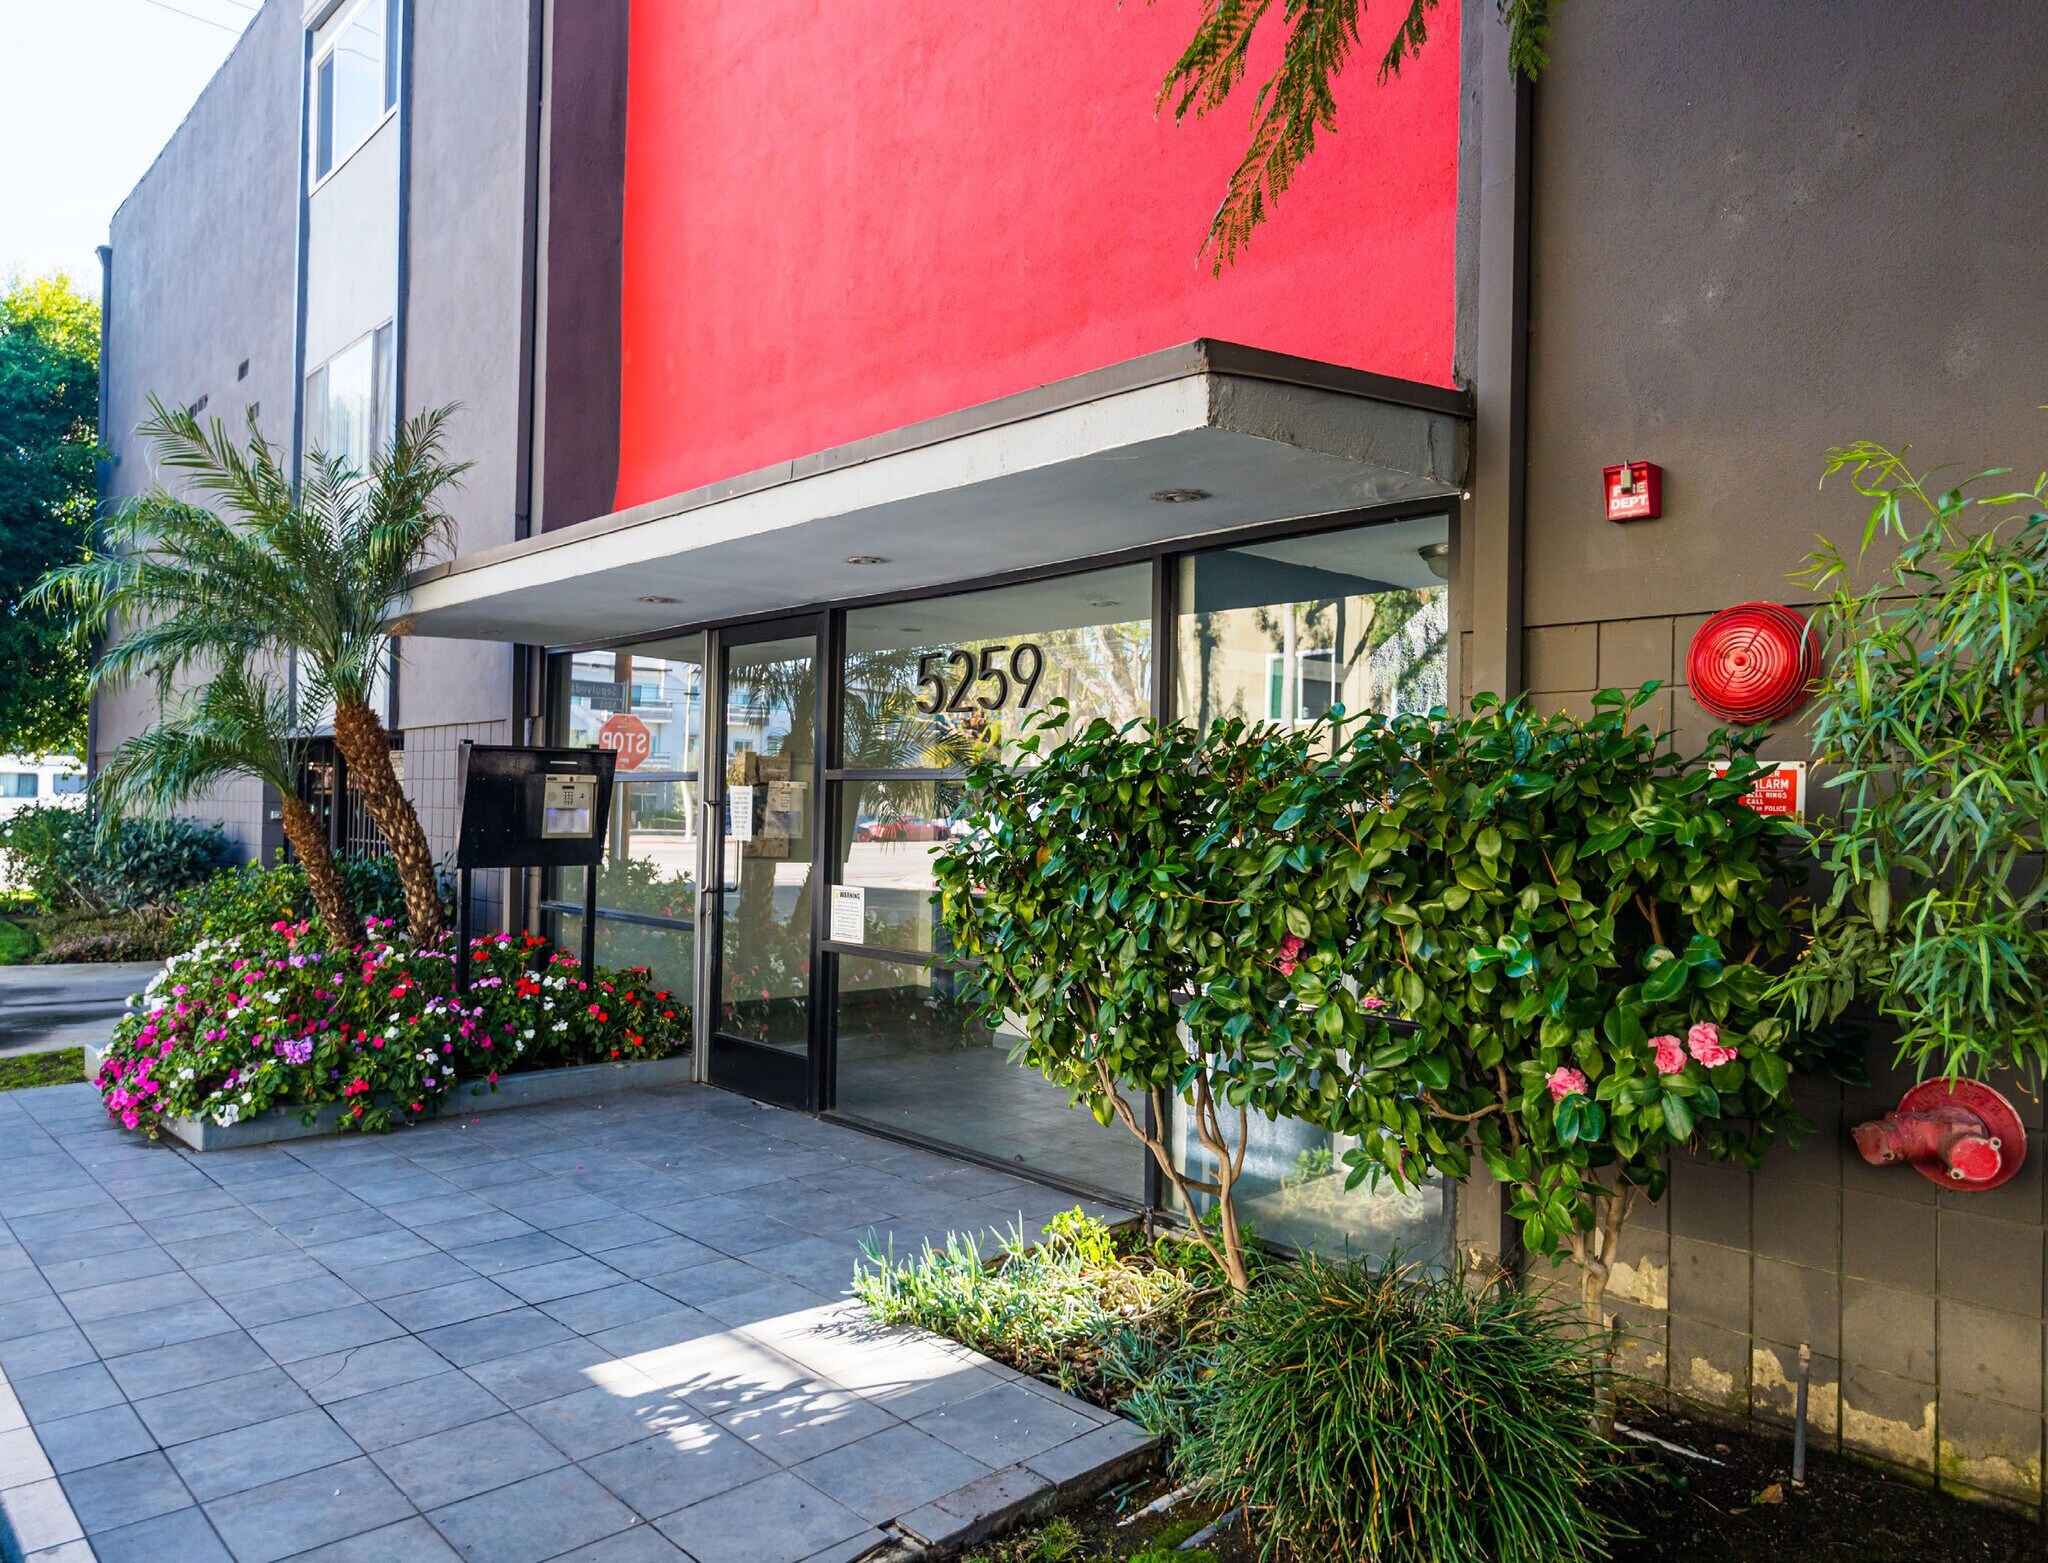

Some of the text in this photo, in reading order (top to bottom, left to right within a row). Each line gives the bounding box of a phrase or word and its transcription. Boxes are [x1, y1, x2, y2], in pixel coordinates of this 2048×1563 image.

[1613, 481, 1646, 497] FE
[1610, 494, 1649, 510] DEPT.
[916, 643, 1044, 714] 5259
[840, 891, 861, 900] WARNING
